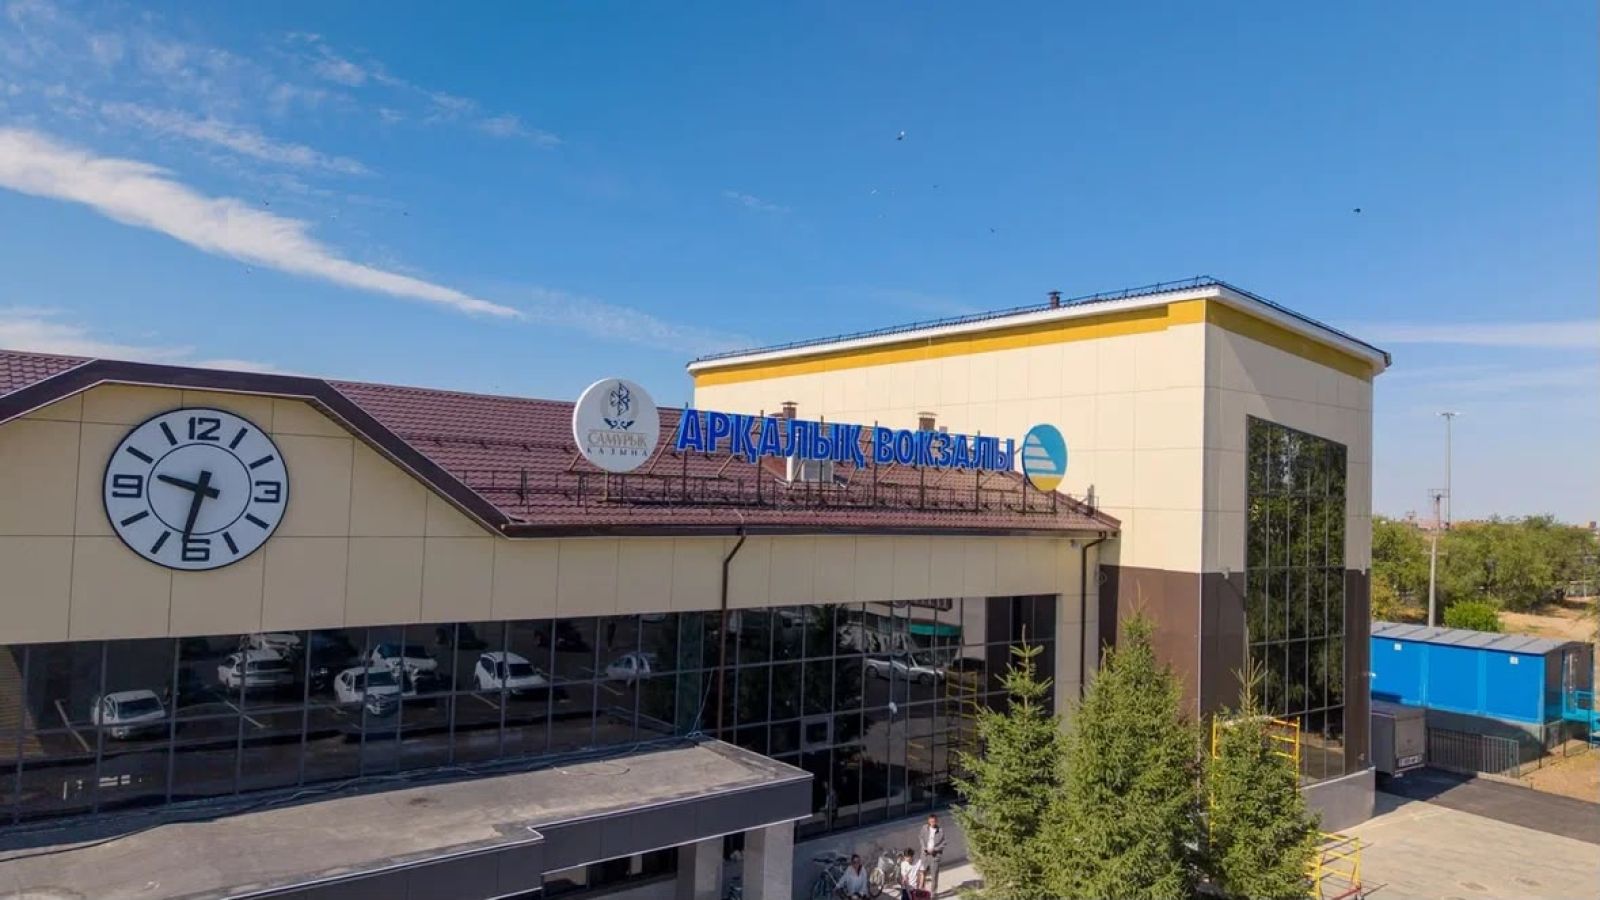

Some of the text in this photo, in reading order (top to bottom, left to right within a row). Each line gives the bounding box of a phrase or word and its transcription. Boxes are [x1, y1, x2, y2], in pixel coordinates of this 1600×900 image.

[188, 417, 221, 441] 12
[677, 408, 1014, 471] АРҚАЛЫҚ ВОКЗАЛЫ
[112, 474, 143, 498] 9
[254, 480, 281, 503] 3
[181, 538, 211, 562] 6
